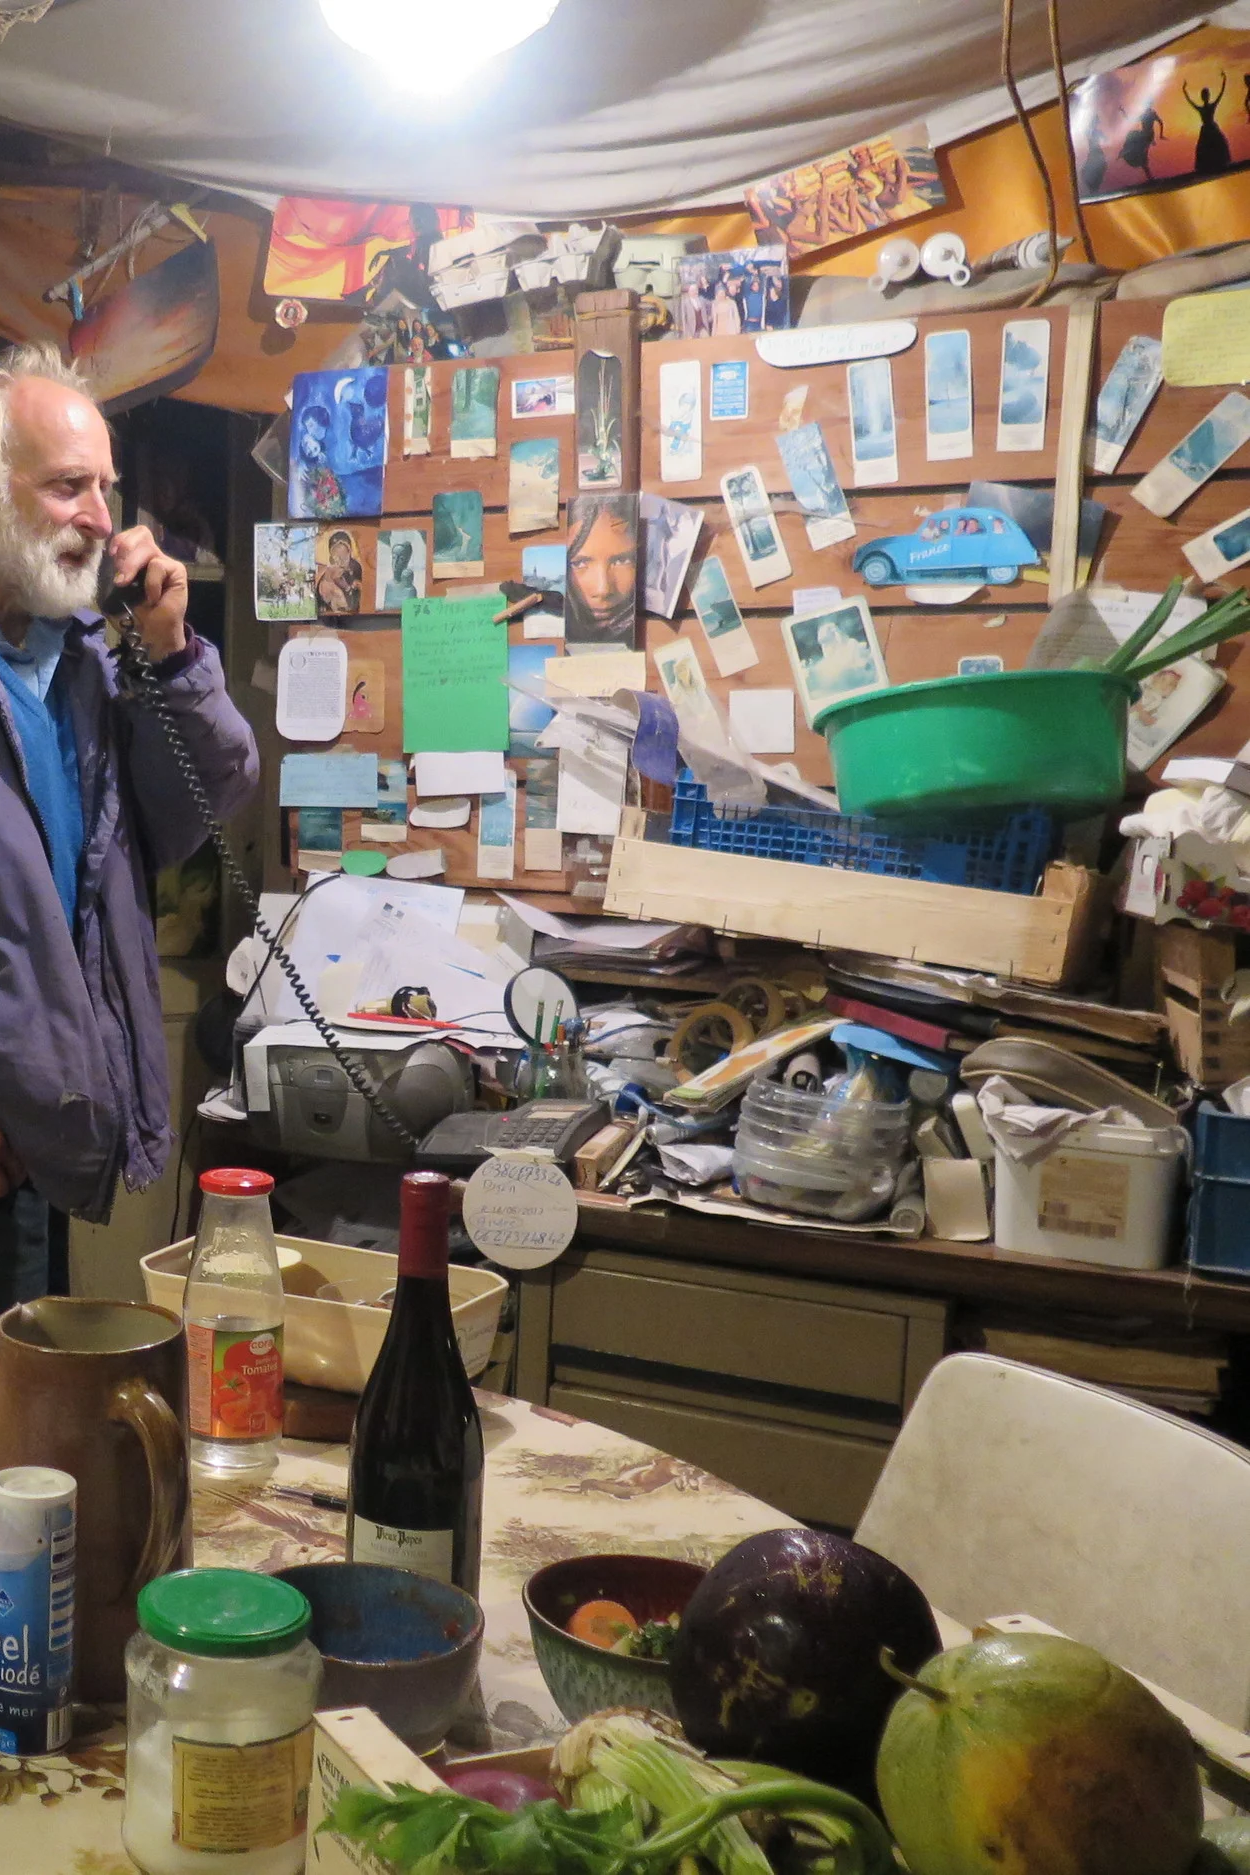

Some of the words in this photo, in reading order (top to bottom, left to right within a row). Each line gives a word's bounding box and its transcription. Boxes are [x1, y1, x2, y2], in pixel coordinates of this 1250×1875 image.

[909, 543, 950, 564] France
[250, 1338, 273, 1350] cora
[0, 1659, 41, 1686] iodé
[9, 1705, 38, 1718] mer
